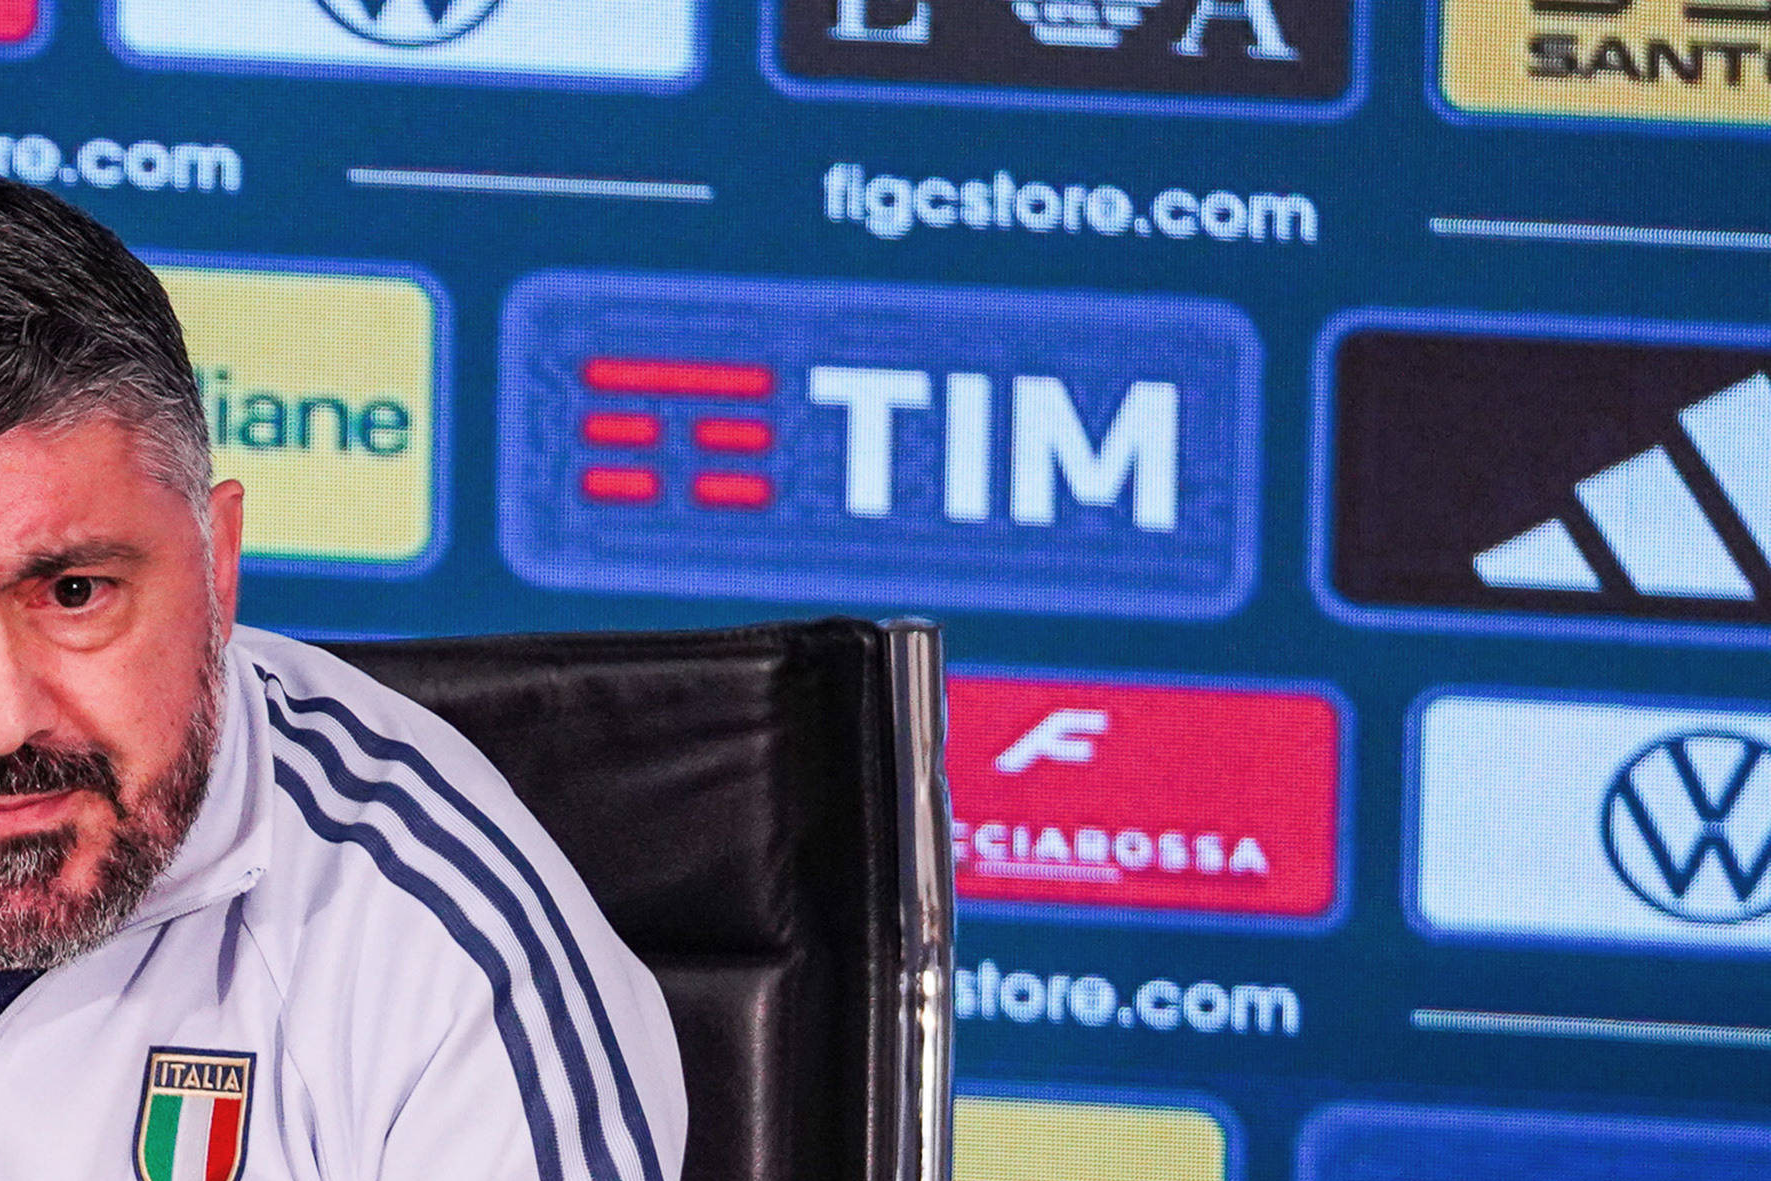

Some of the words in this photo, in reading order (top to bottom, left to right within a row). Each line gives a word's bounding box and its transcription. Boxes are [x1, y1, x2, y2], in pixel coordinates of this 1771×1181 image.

[1528, 36, 1771, 88] SANT
[824, 162, 1318, 243] figcstore.com
[808, 367, 1178, 533] TIM
[158, 1061, 242, 1092] ITALIA
